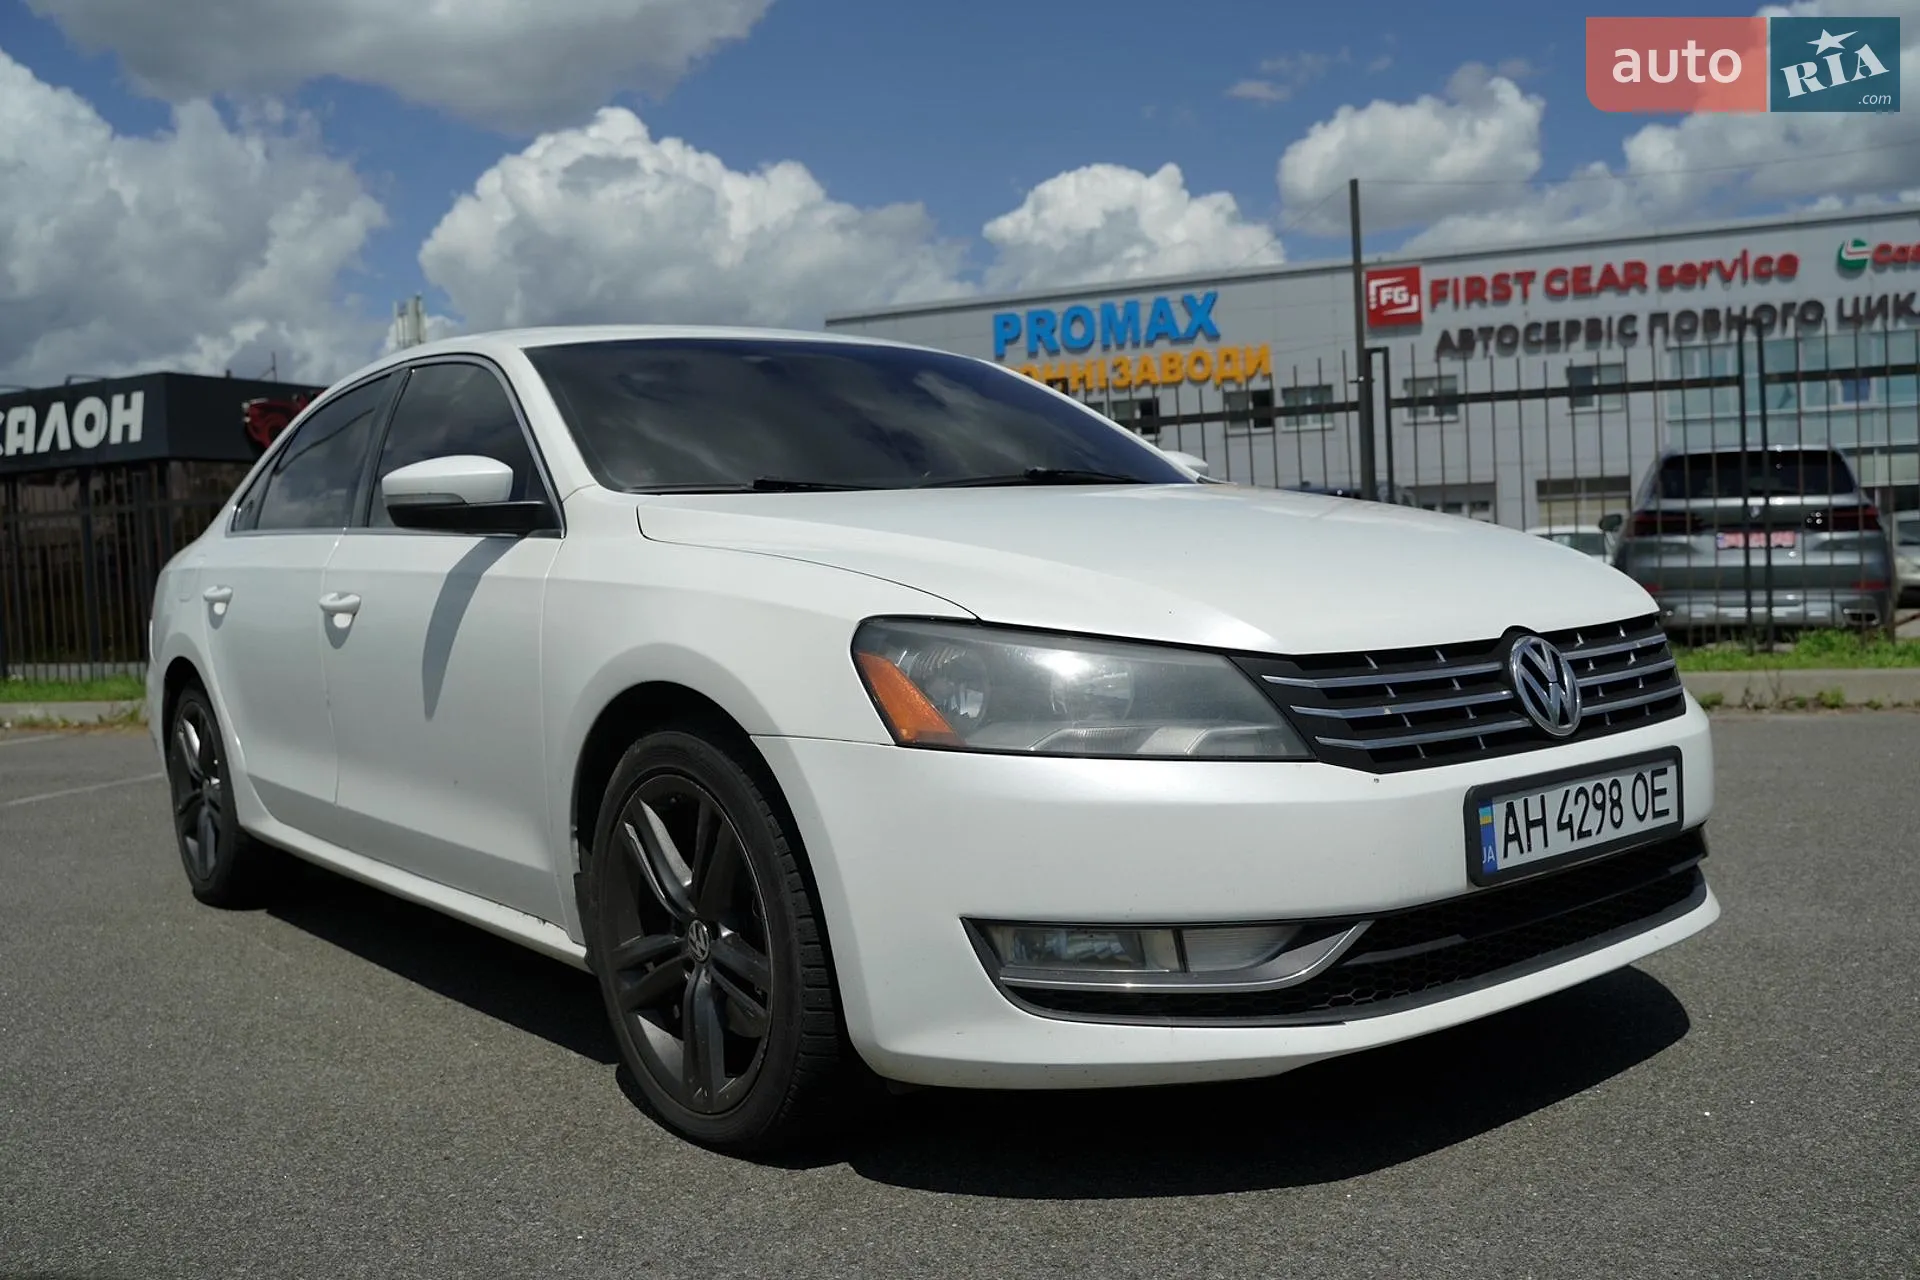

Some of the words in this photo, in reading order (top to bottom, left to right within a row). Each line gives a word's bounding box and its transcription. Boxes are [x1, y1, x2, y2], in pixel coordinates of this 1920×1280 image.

[1380, 285, 1410, 306] FG
[1429, 271, 1536, 309] FIRST
[1544, 260, 1648, 298] GEAR
[1657, 248, 1799, 290] service
[993, 291, 1219, 358] PROMAX
[1435, 314, 1638, 360] АВТОСЕРВІС
[1649, 299, 1825, 342] ПОВНОГО
[1111, 343, 1272, 389] ЗАВОДИ
[0, 391, 145, 457] АЛОН
[1503, 794, 1549, 859] AH
[1557, 778, 1624, 843] 4298
[1632, 767, 1670, 823] OE
